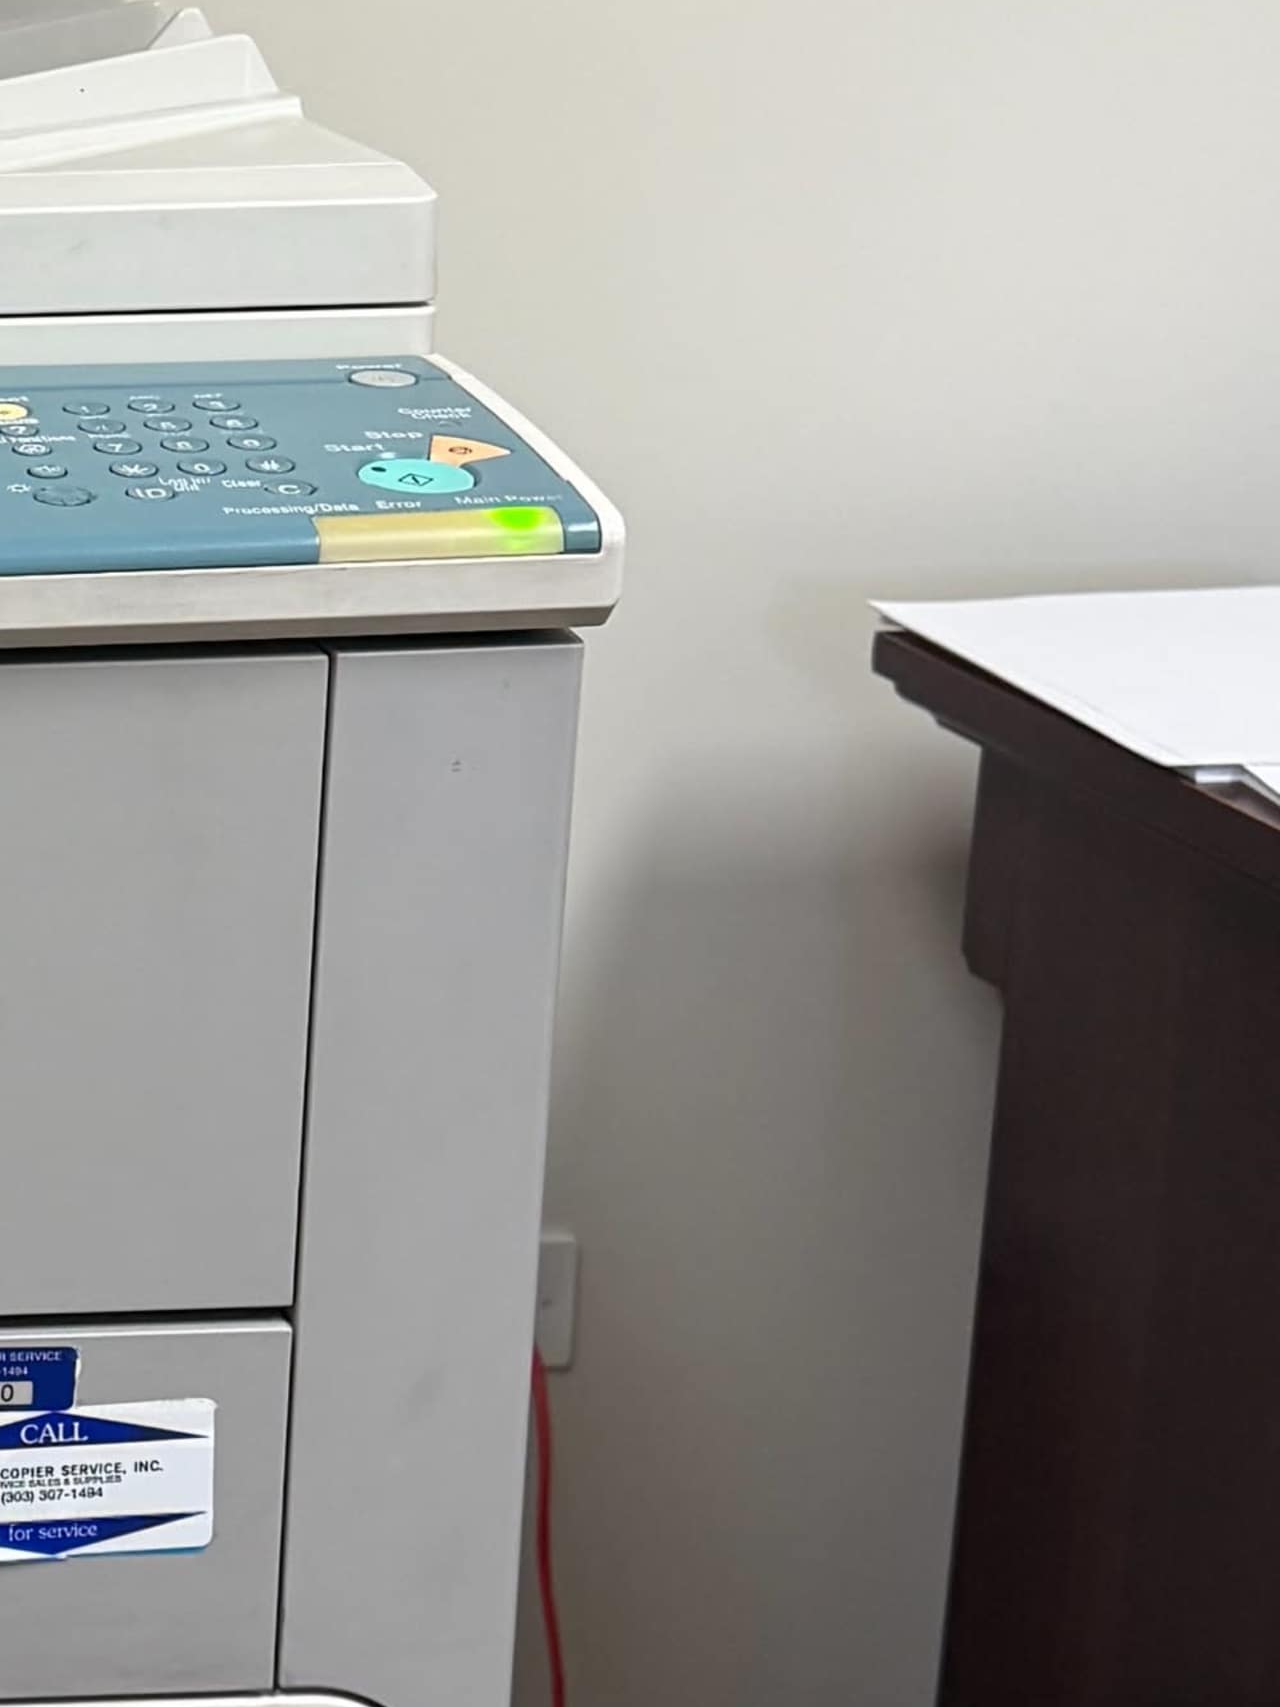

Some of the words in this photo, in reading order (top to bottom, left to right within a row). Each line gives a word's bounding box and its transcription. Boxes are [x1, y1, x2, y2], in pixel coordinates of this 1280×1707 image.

[364, 431, 423, 439] Stop
[324, 443, 384, 452] Start
[223, 501, 359, 516] Processing/Data
[376, 499, 422, 509] Error
[9, 1350, 62, 1362] SERVICE
[20, 1422, 88, 1444] CALL
[0, 1465, 54, 1480] COPIER
[61, 1462, 126, 1477] SERVICE,
[134, 1459, 164, 1473] INC.
[1, 1490, 34, 1505] (303)
[8, 1524, 32, 1542] for
[38, 1524, 98, 1540] service
